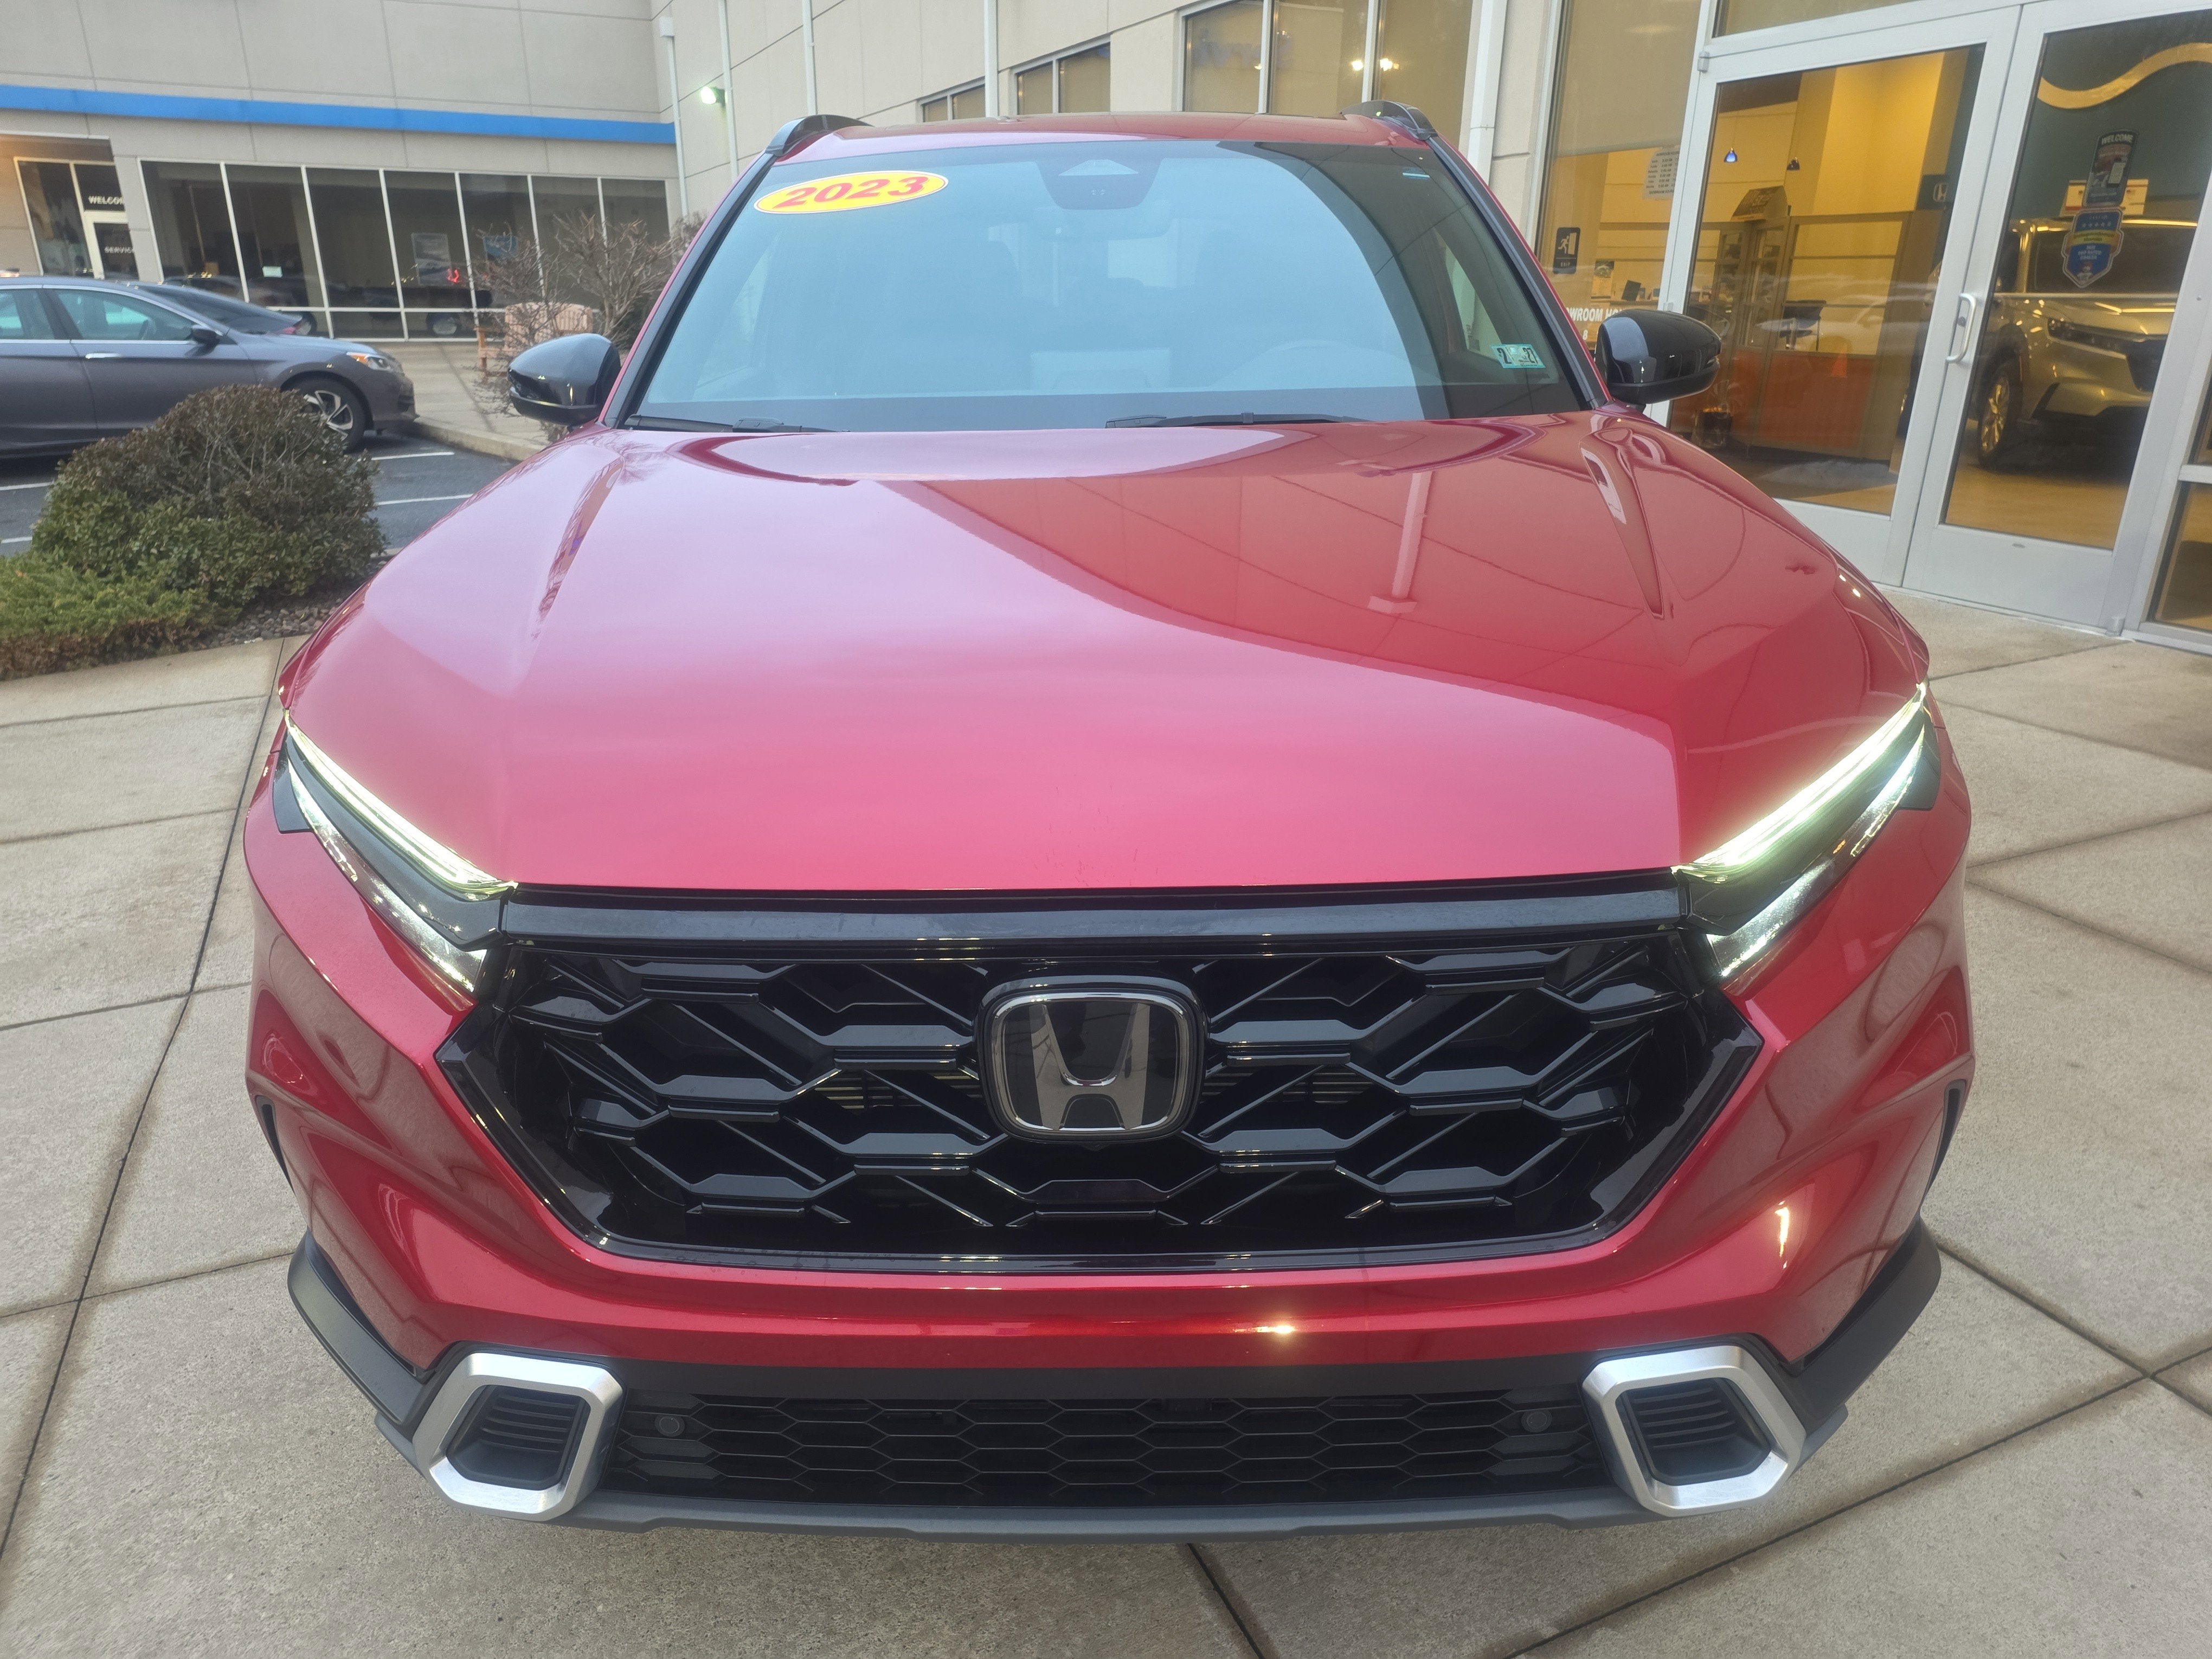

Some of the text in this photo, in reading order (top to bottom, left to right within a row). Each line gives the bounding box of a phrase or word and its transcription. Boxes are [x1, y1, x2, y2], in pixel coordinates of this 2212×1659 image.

[2101, 133, 2133, 145] WELCOME
[772, 176, 929, 209] 2023
[1582, 329, 1589, 340] 8
[1496, 347, 1539, 365] 2 27
